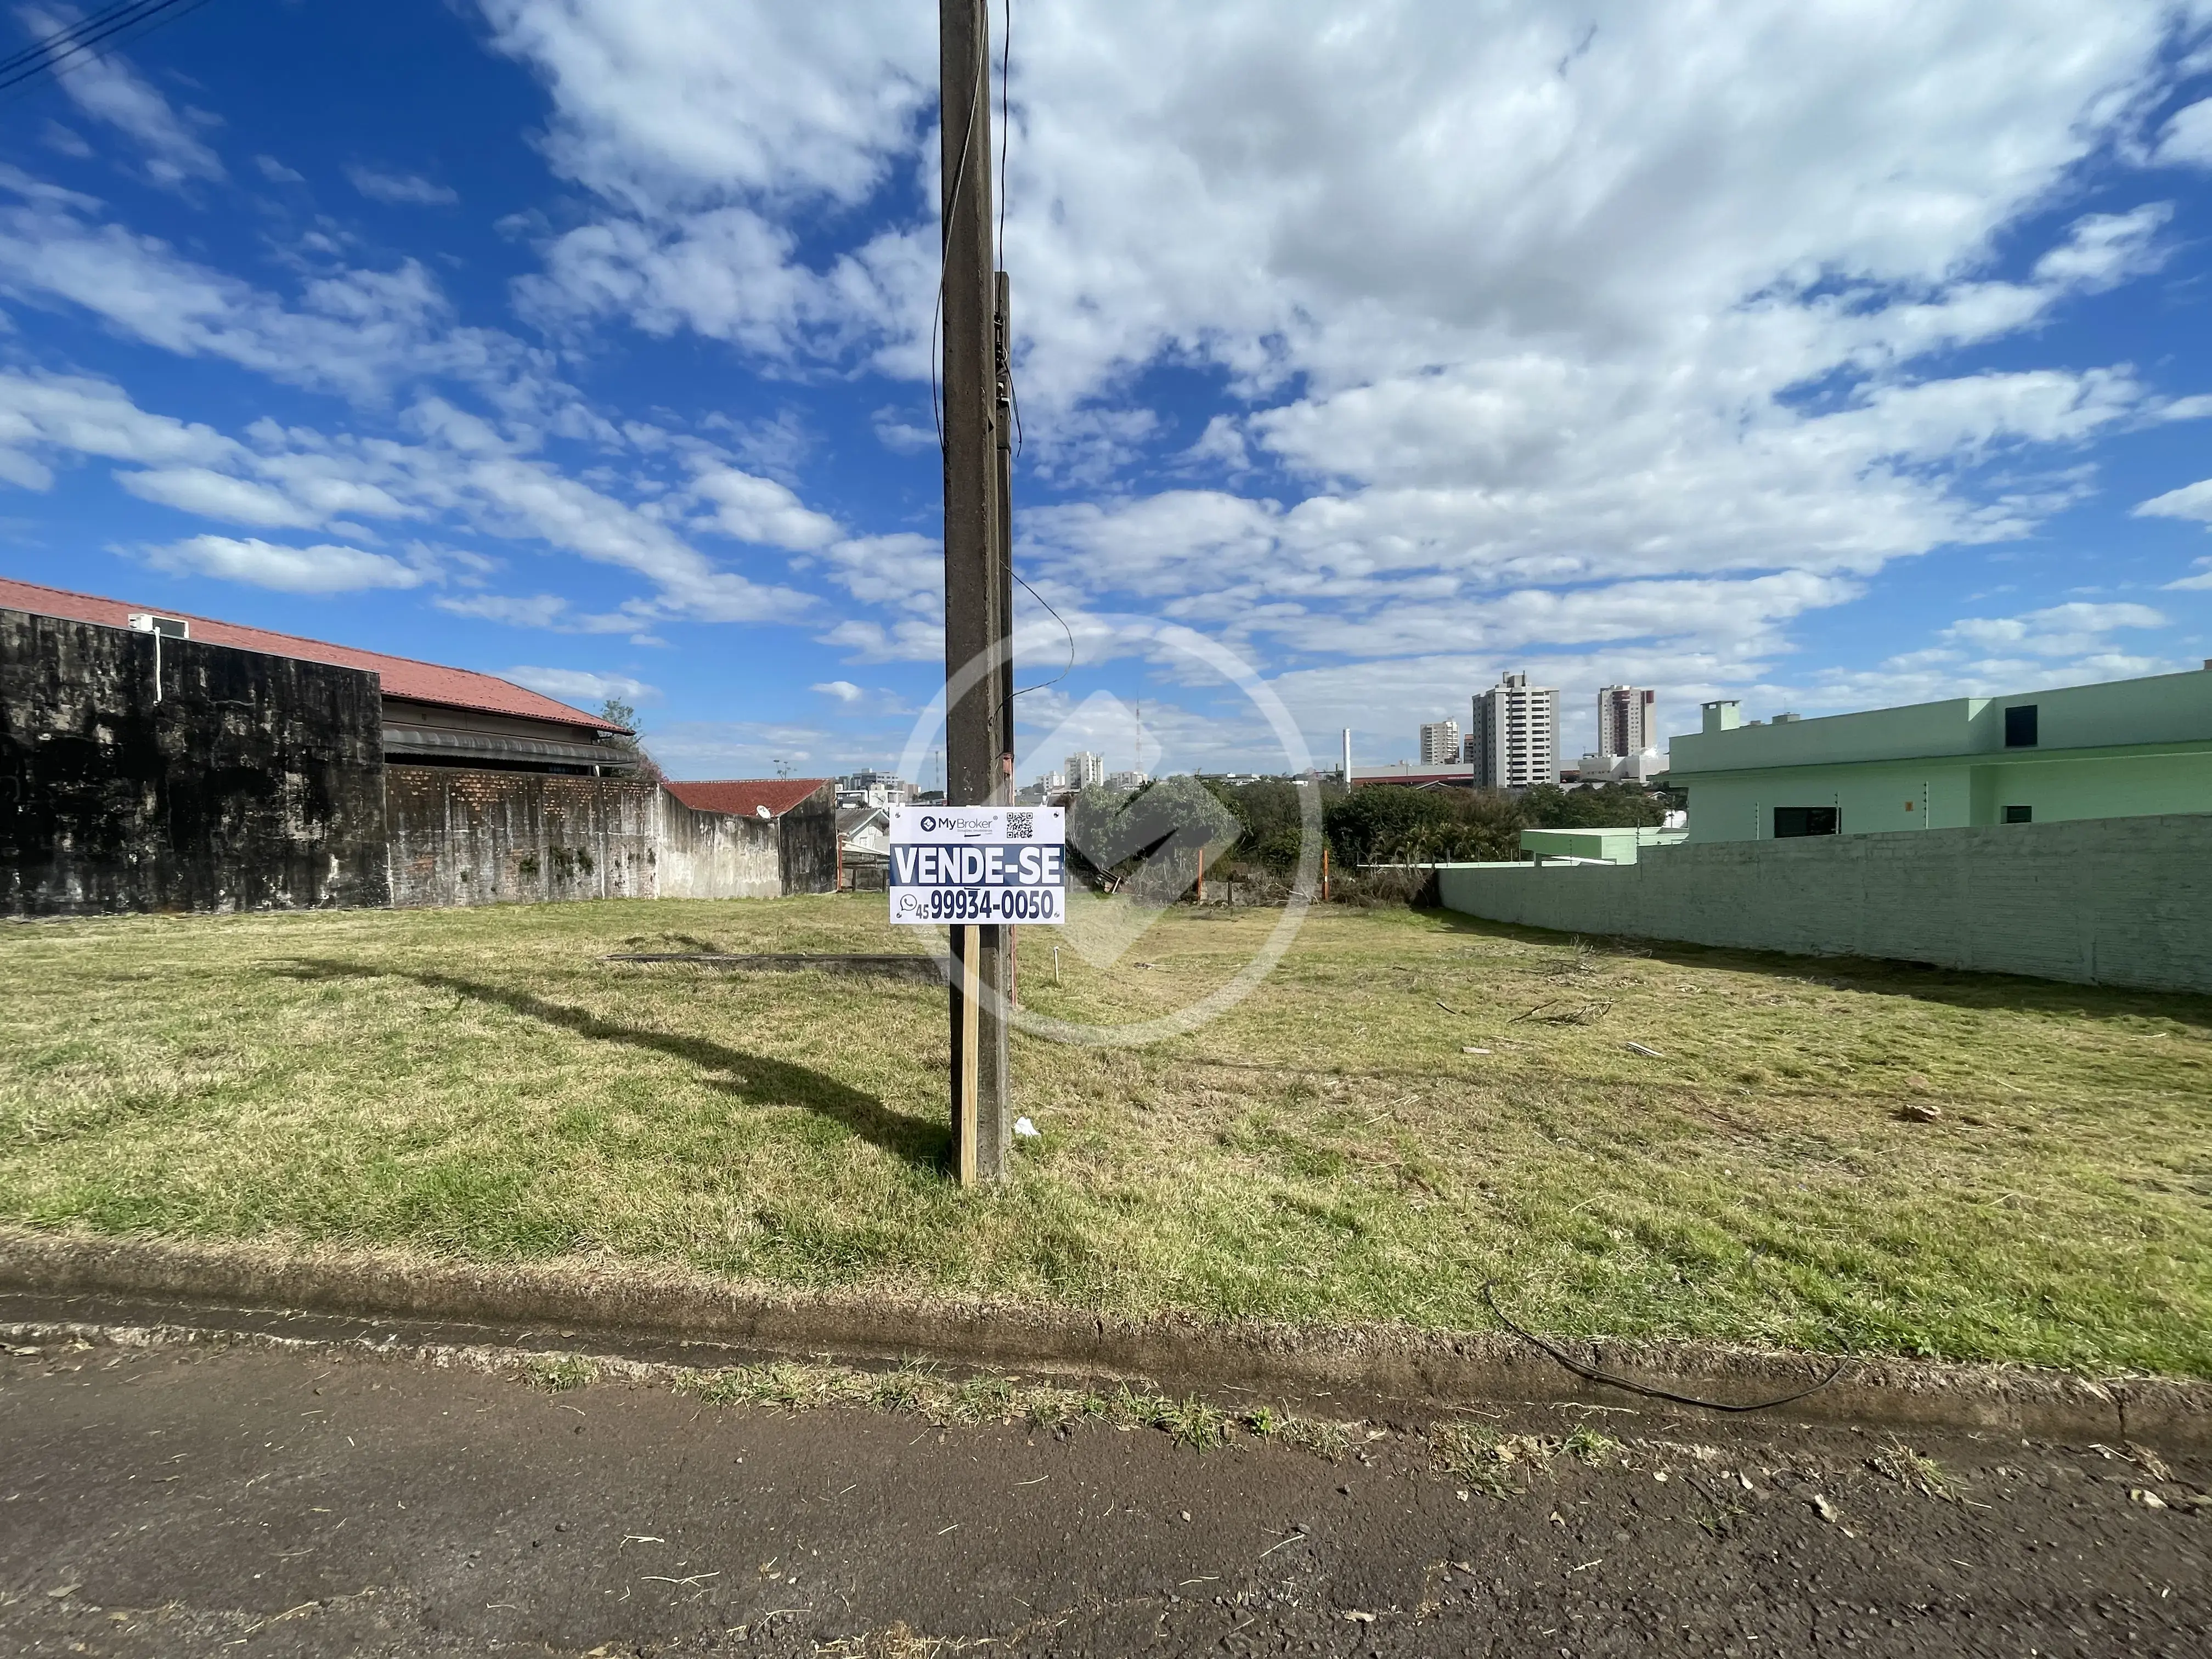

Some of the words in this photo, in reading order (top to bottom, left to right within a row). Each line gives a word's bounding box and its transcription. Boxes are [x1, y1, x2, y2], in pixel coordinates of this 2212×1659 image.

[939, 817, 992, 830] MyBroker
[894, 847, 1060, 884] VENDE-SE
[916, 904, 929, 919] 45
[931, 890, 1053, 919] 99934-0050
